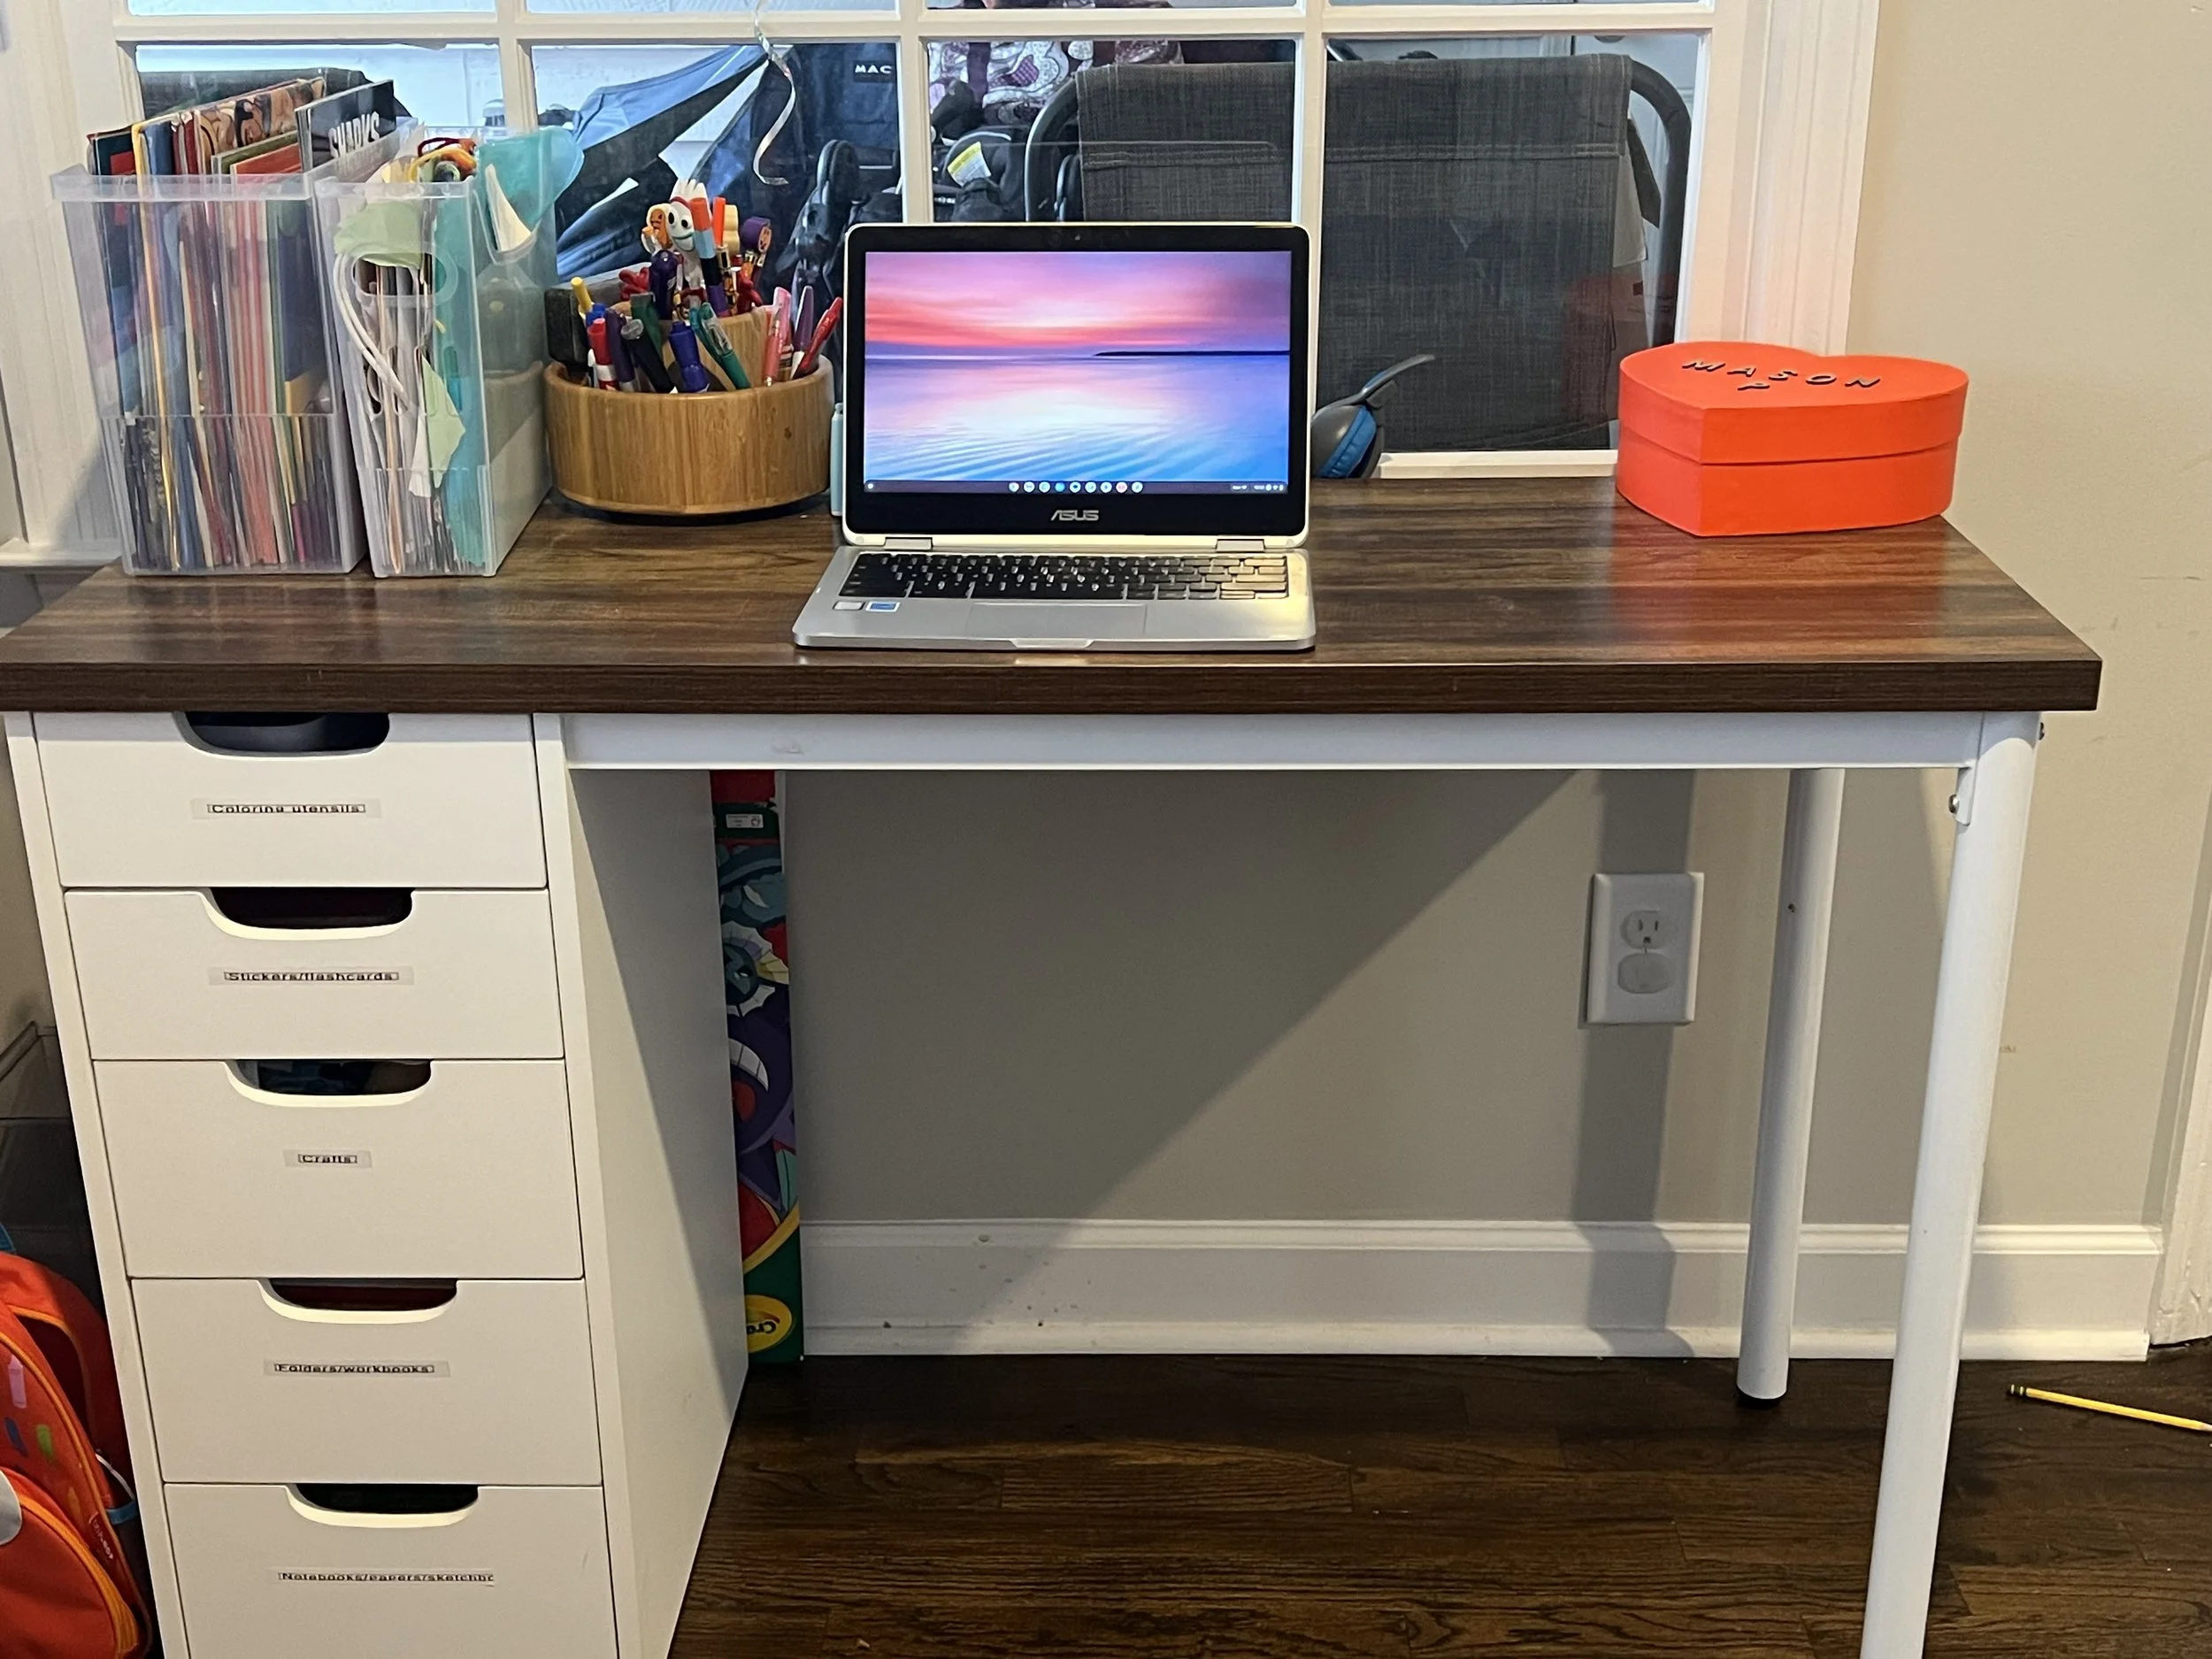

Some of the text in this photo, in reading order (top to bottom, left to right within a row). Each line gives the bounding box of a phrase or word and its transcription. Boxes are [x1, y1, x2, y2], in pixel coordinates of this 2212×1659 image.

[854, 64, 893, 74] MAC
[1681, 361, 1881, 388] MASON
[1050, 510, 1100, 521] ASUS
